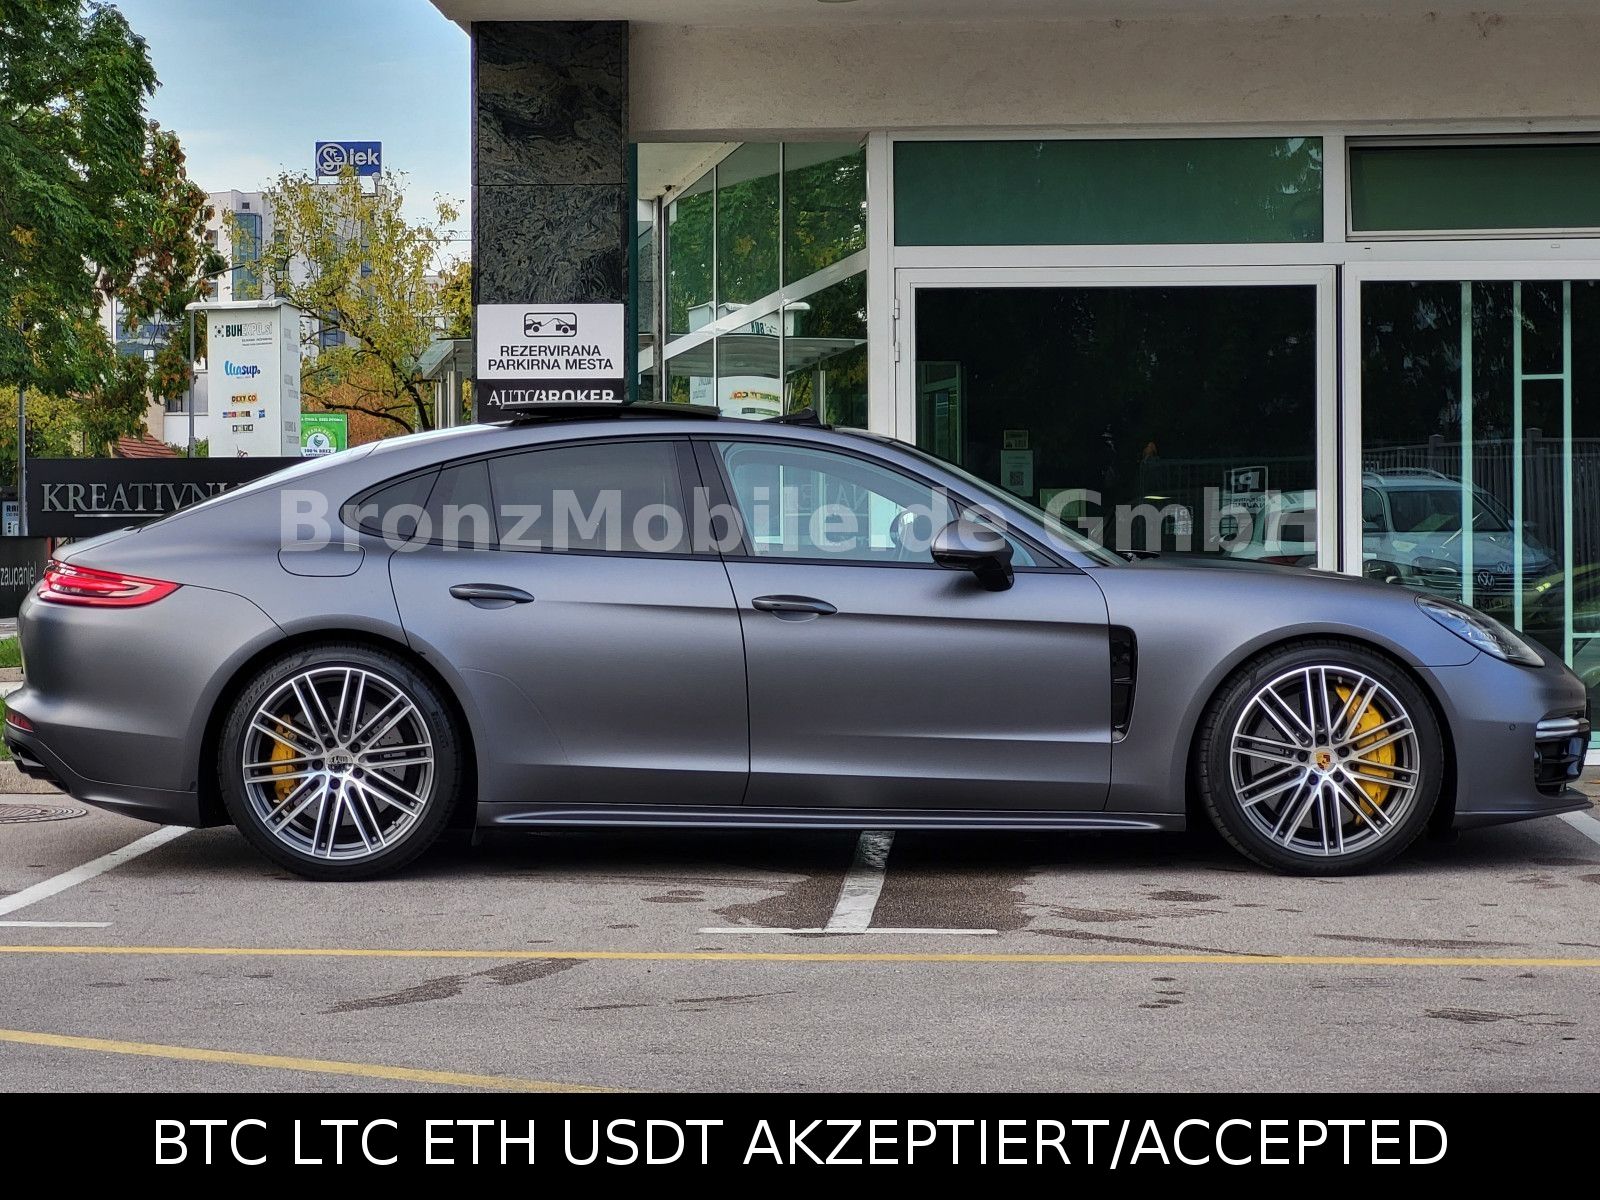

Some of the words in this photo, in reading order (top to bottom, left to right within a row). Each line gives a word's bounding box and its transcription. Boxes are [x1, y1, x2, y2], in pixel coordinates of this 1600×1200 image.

[350, 148, 380, 166] lek
[500, 345, 602, 357] REZERVIRANA
[488, 359, 561, 371] PARKIRNA
[565, 359, 614, 371] MESTA
[0, 560, 37, 593] zaupanje!
